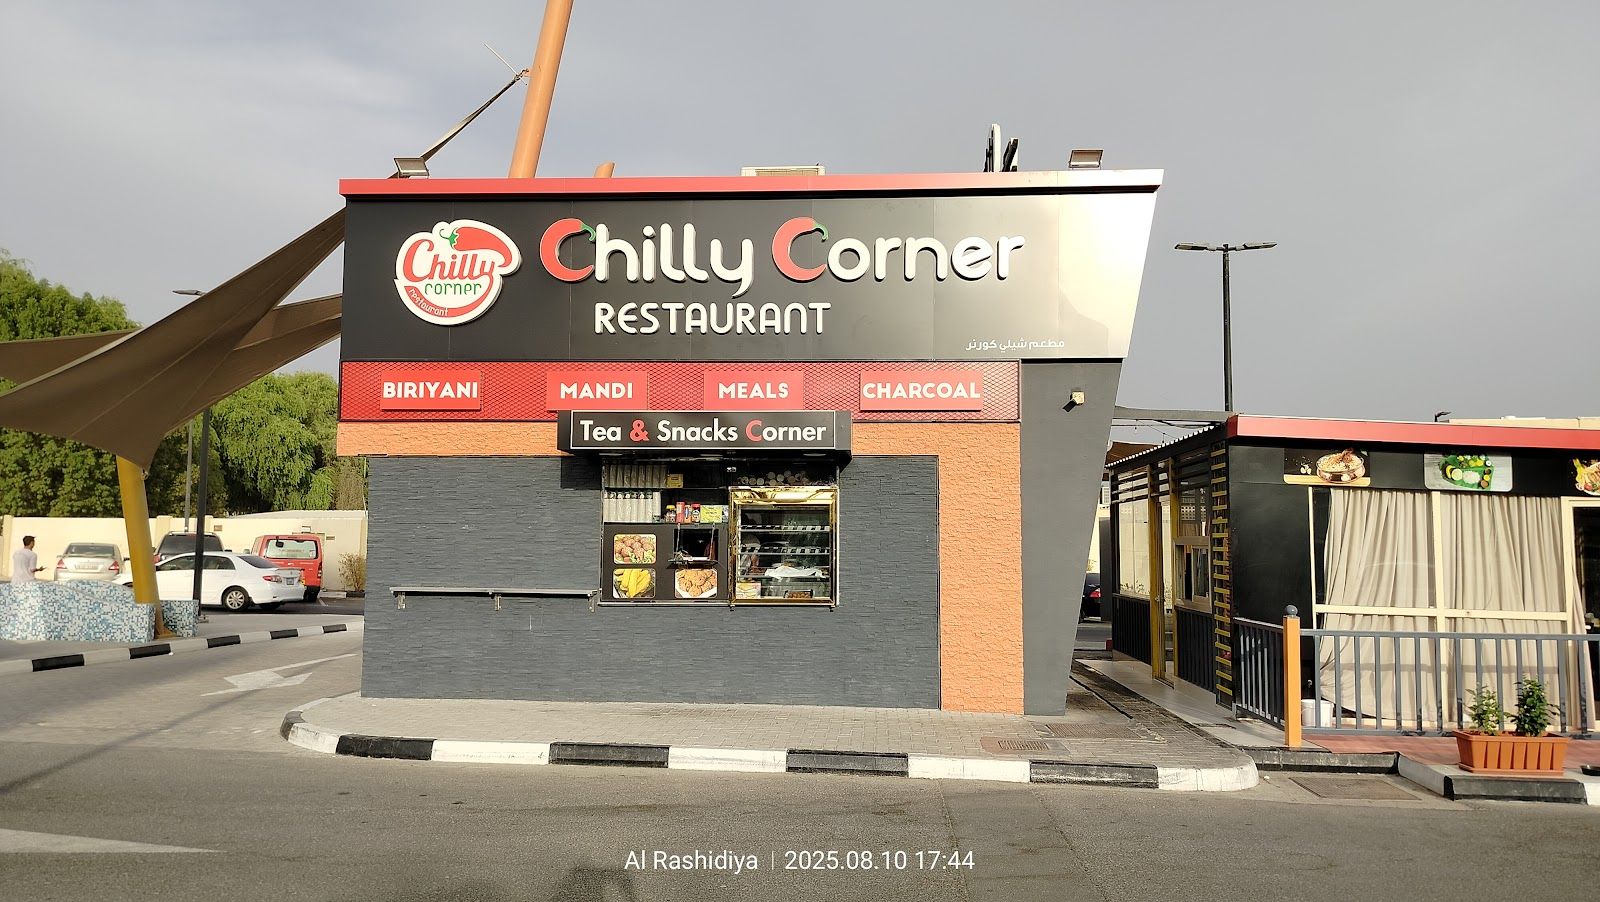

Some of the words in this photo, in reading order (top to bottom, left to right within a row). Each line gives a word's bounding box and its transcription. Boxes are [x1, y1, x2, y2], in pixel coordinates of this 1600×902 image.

[403, 239, 495, 283] Chilly
[539, 217, 755, 298] Chilly
[771, 216, 1025, 283] Corner
[424, 283, 482, 295] corner
[408, 288, 449, 317] restaurant
[594, 302, 832, 336] RESTAURANT
[966, 339, 998, 351] كورنر
[999, 338, 1027, 353] شيلي
[1029, 339, 1065, 350] مطعم
[382, 381, 479, 399] BIRIYANI
[560, 382, 633, 399] MANDI
[718, 382, 790, 399] MEALS
[862, 382, 981, 399] CHARCOAL
[580, 419, 622, 441] Tea
[629, 419, 650, 441] &
[657, 418, 738, 442] Snacks
[746, 418, 827, 442] Corner
